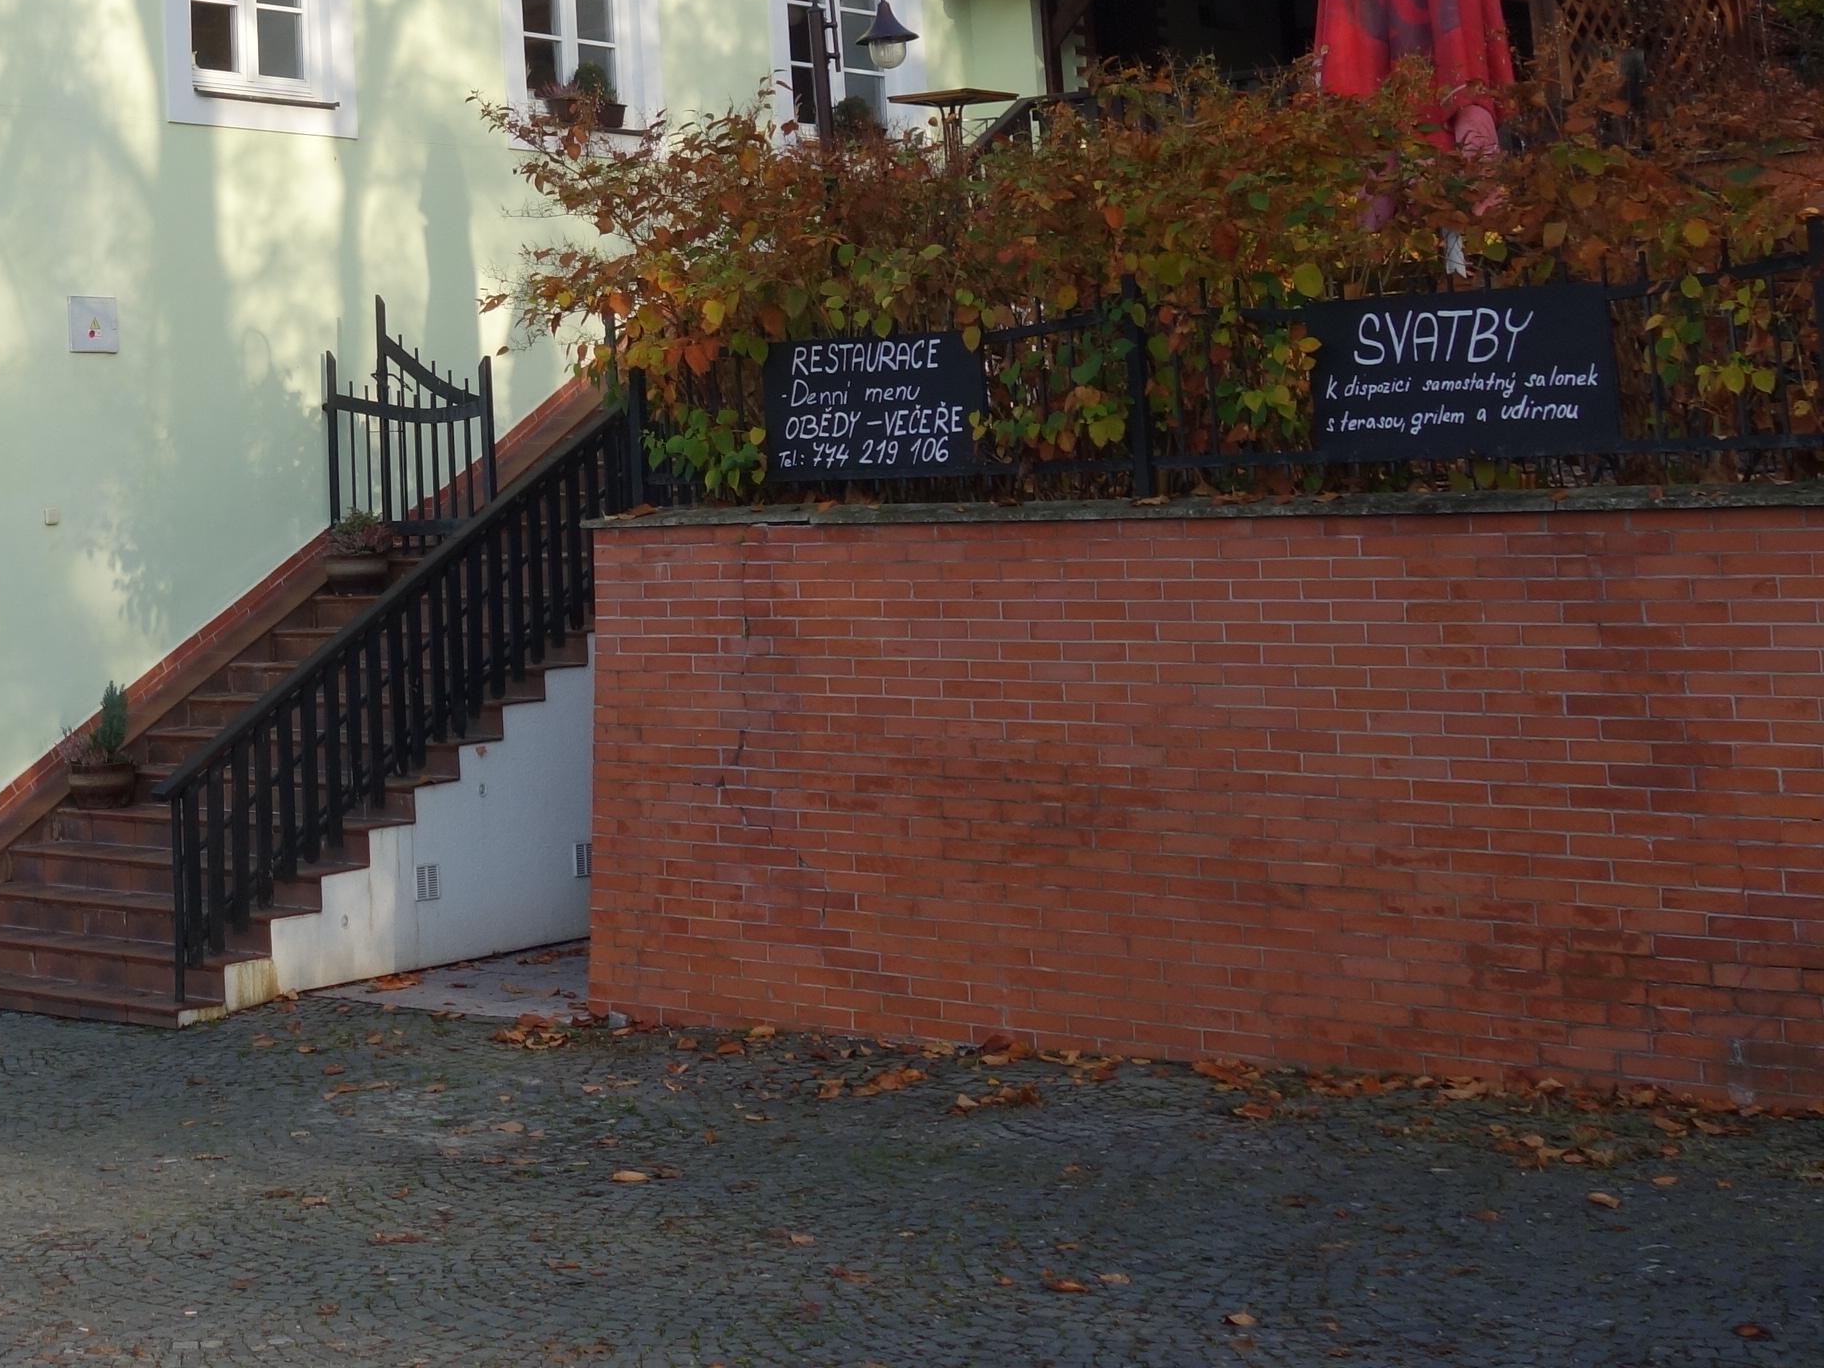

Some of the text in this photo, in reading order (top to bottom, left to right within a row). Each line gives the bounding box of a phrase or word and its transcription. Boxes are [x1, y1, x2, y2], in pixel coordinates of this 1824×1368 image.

[1353, 307, 1534, 365] SVATBY
[791, 338, 940, 375] RESTAURACE
[865, 385, 921, 403] menu
[1422, 372, 1516, 398] samostatný
[1524, 363, 1599, 388] salonek
[785, 407, 861, 440] OBĚDY
[1411, 405, 1465, 435] grilem
[1477, 408, 1487, 421] a
[813, 442, 850, 469] 774
[859, 440, 899, 465] 219
[910, 436, 949, 465] 106
